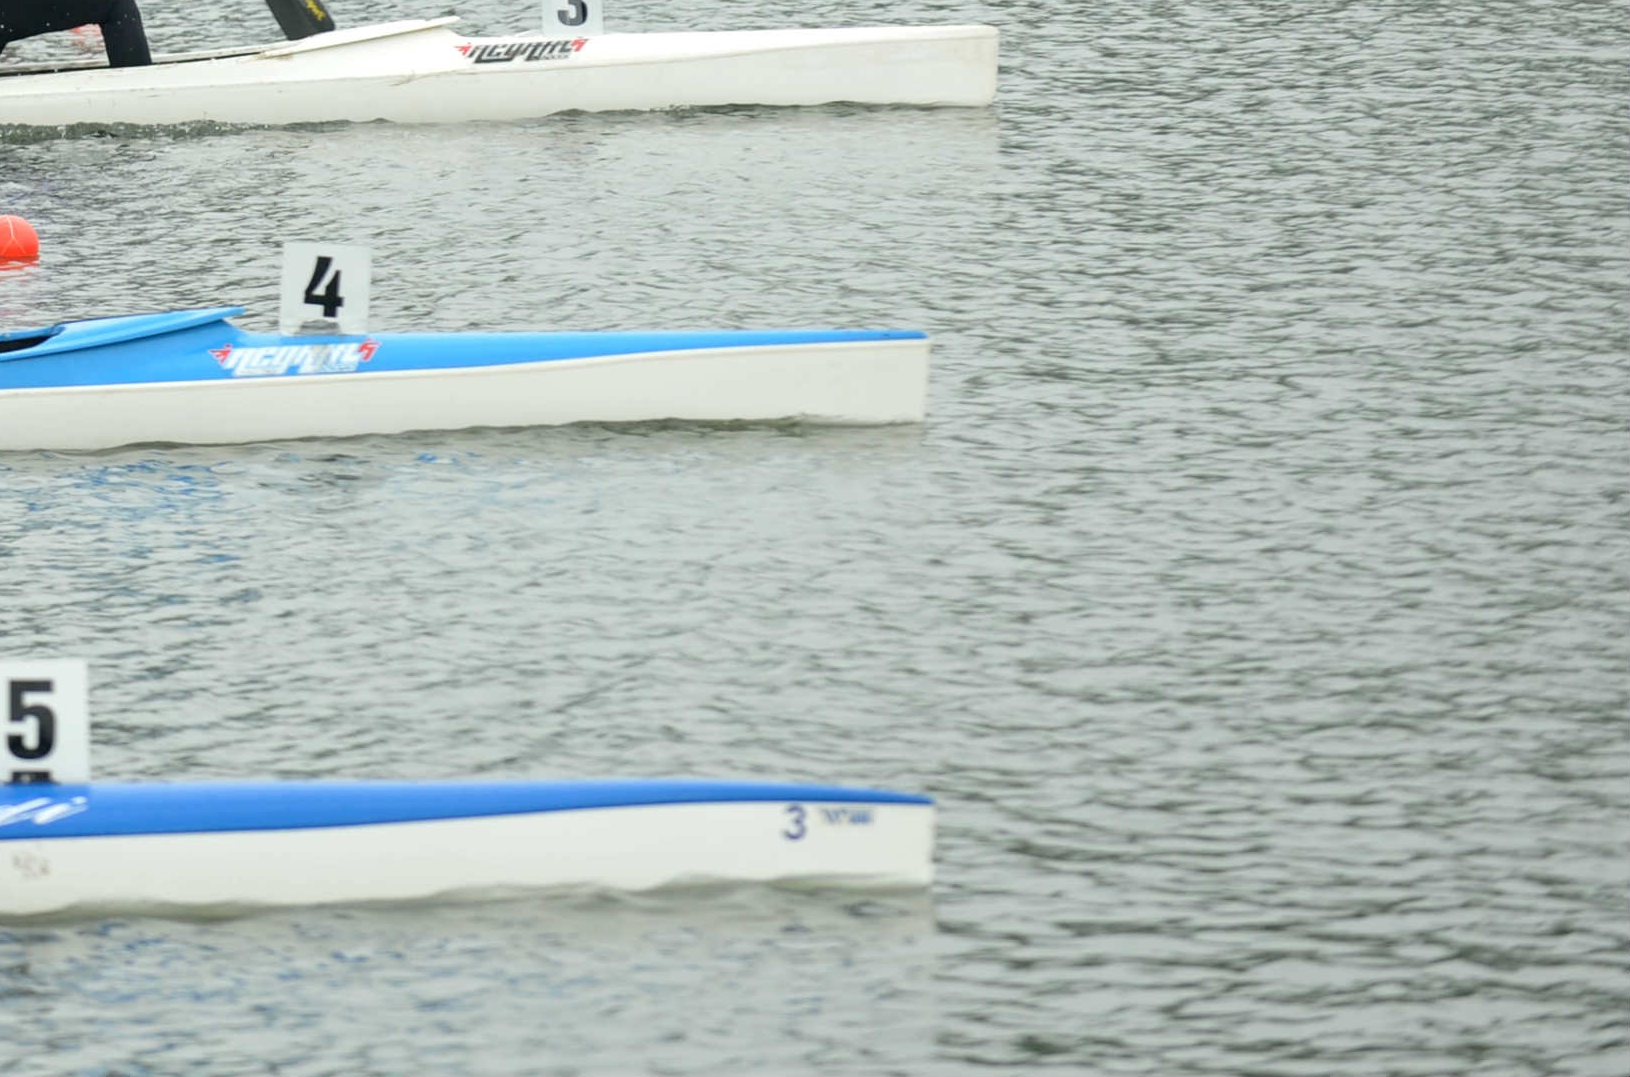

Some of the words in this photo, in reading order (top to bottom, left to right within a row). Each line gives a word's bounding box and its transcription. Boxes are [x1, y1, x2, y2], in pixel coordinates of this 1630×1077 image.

[304, 256, 344, 318] 4
[6, 680, 55, 760] 5
[781, 804, 806, 841] 3
